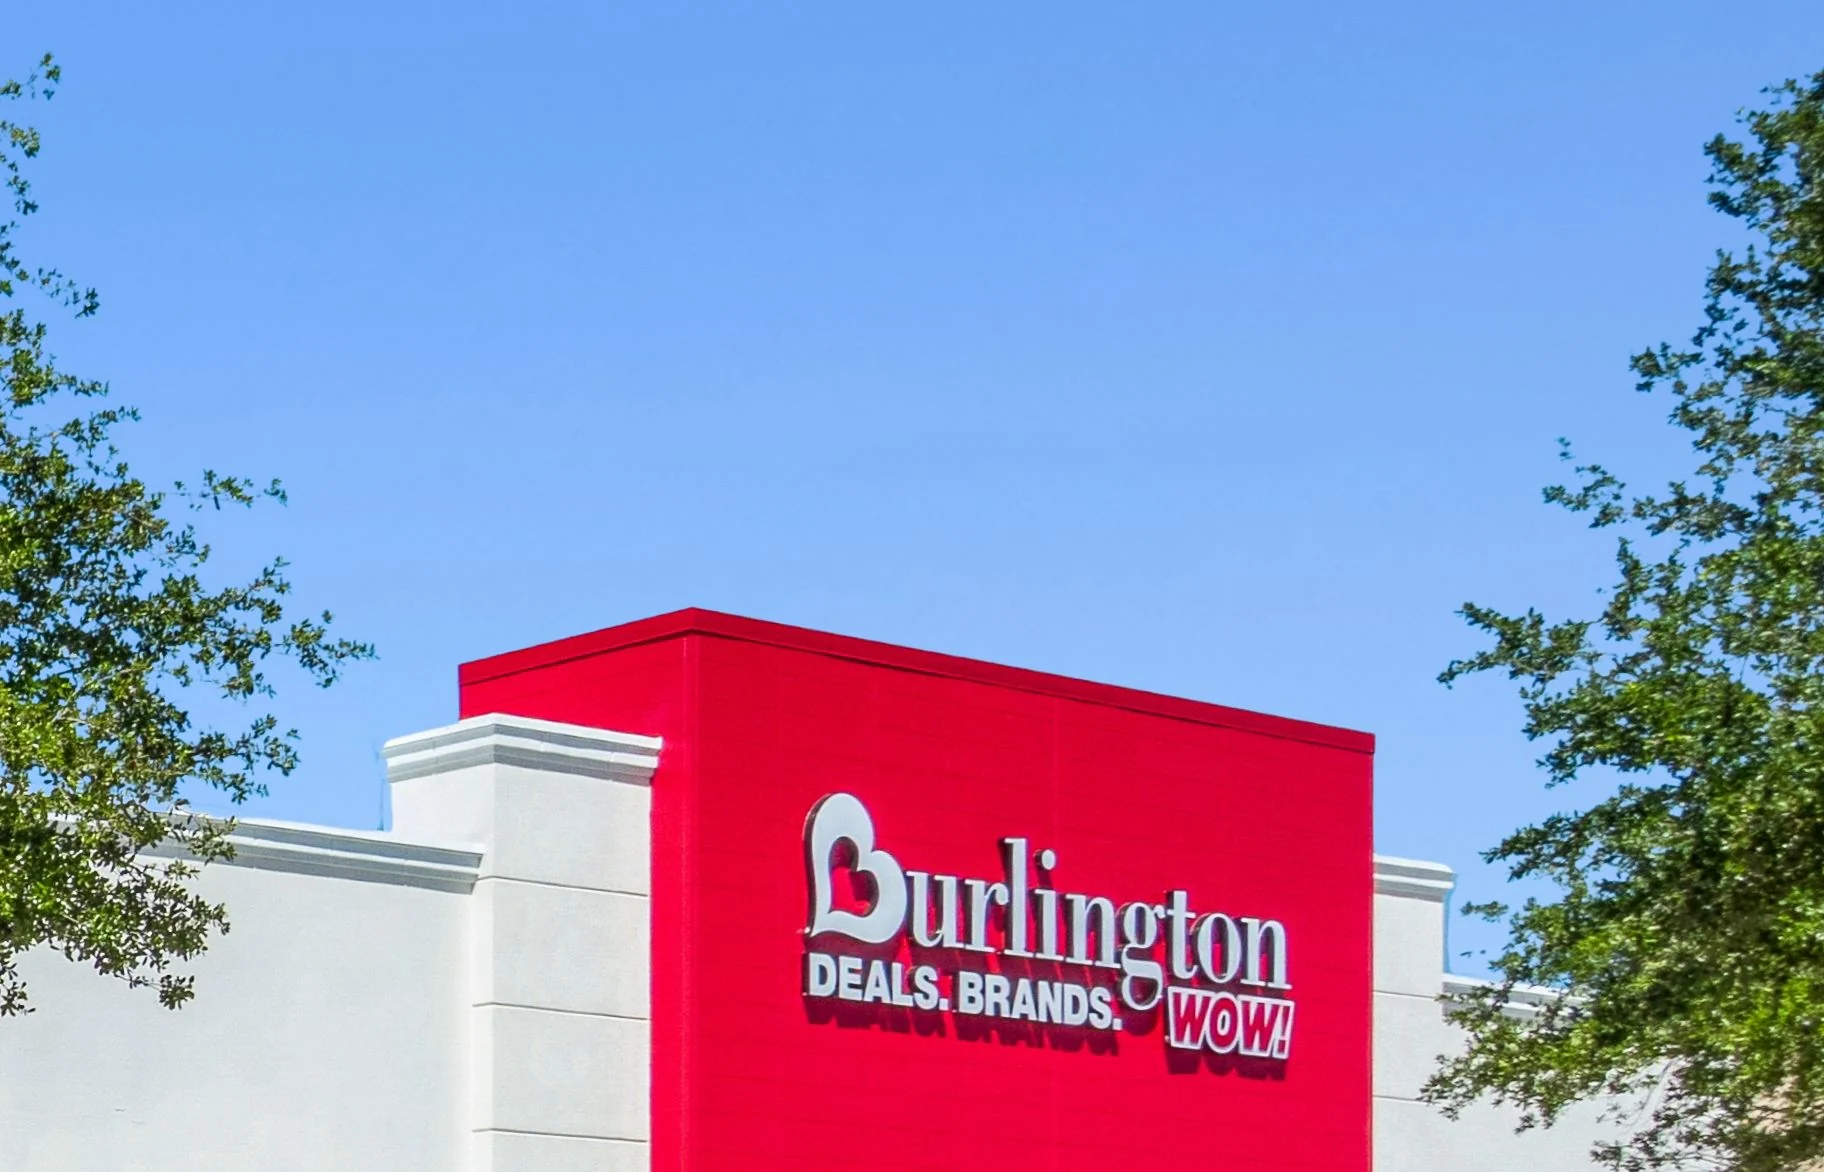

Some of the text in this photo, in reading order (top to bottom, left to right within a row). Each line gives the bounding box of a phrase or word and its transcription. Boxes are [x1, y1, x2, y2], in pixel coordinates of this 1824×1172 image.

[804, 793, 1292, 1010] Burlington
[808, 954, 1122, 1031] DEALS. BRANDS.
[1167, 986, 1295, 1059] WOW!
